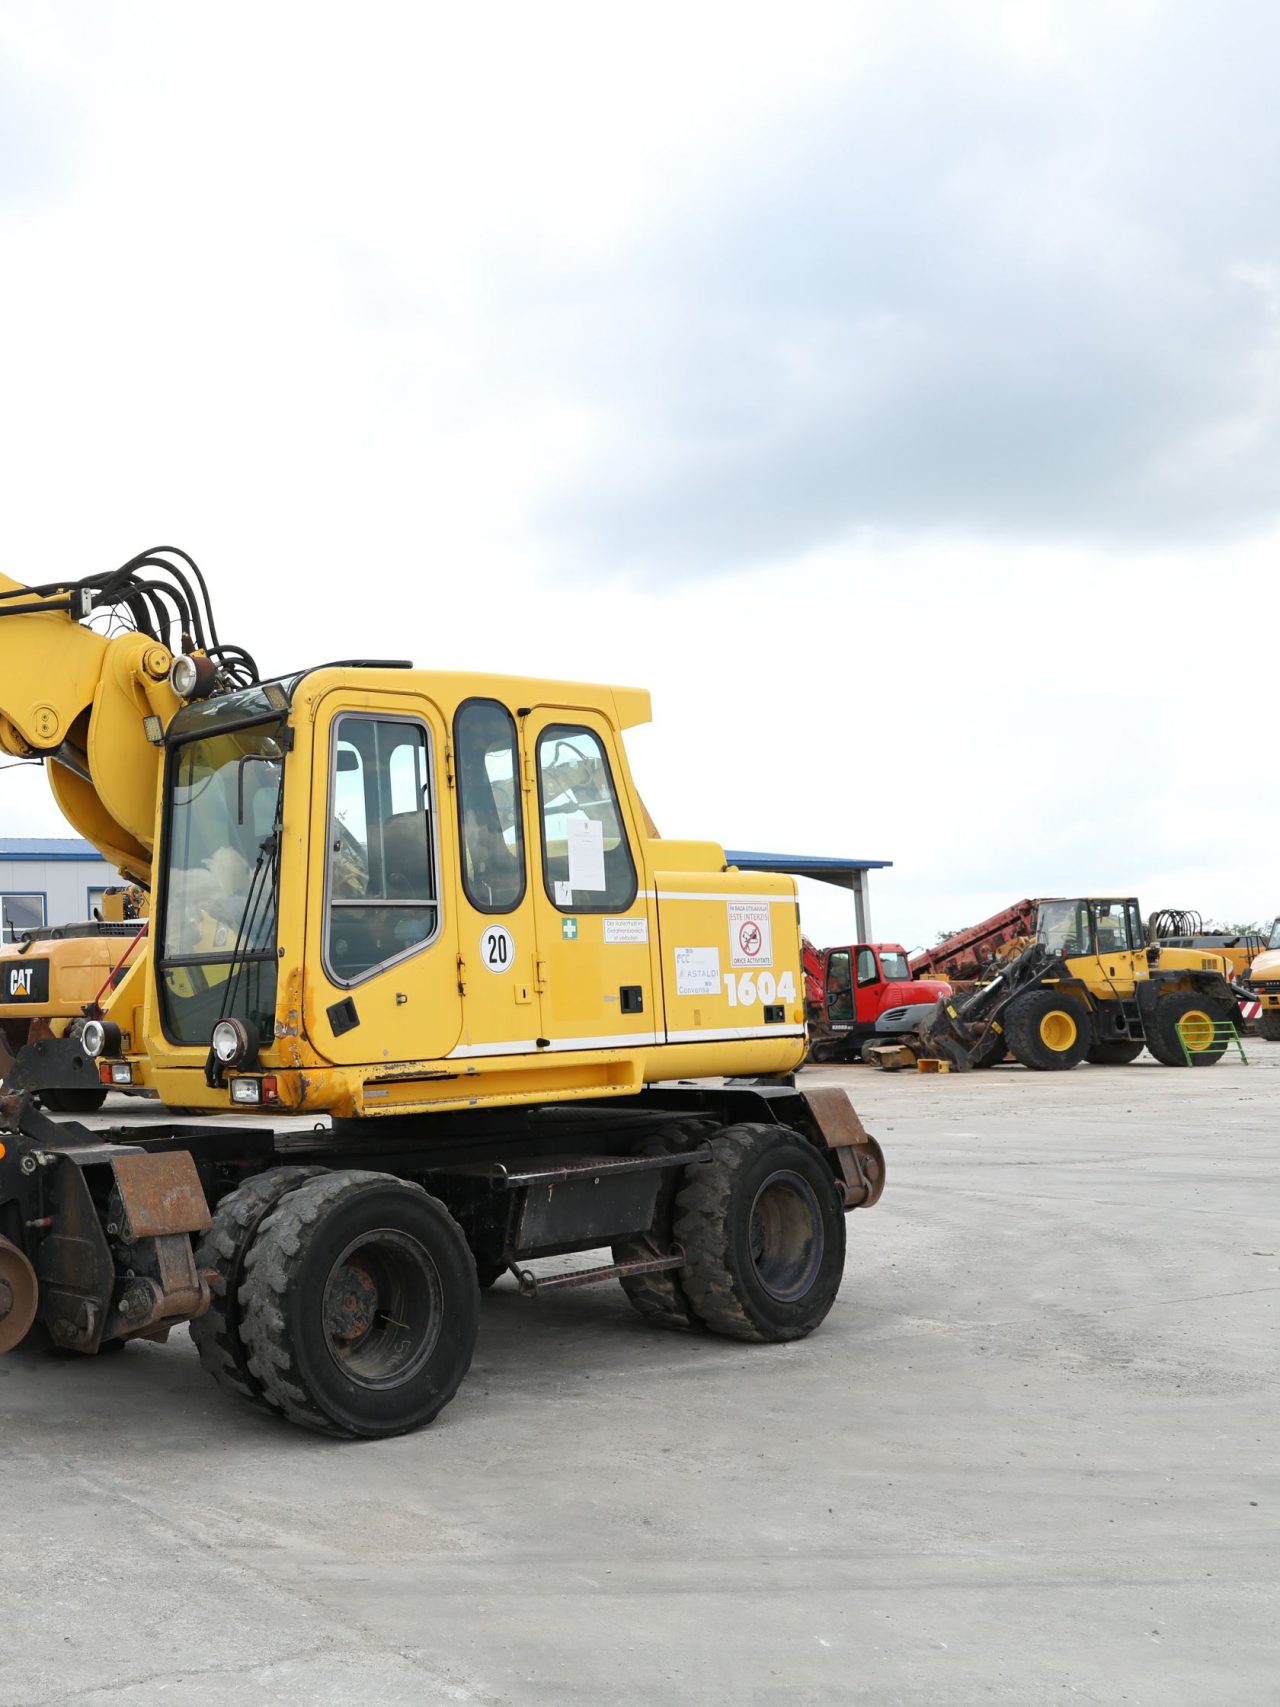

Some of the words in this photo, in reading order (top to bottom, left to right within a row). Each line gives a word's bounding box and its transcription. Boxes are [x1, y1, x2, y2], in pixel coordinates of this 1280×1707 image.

[744, 913, 768, 921] INTERZIS
[488, 934, 507, 964] 20
[10, 968, 33, 996] CAT
[687, 969, 719, 978] ASTALDI
[724, 971, 796, 1007] 1604
